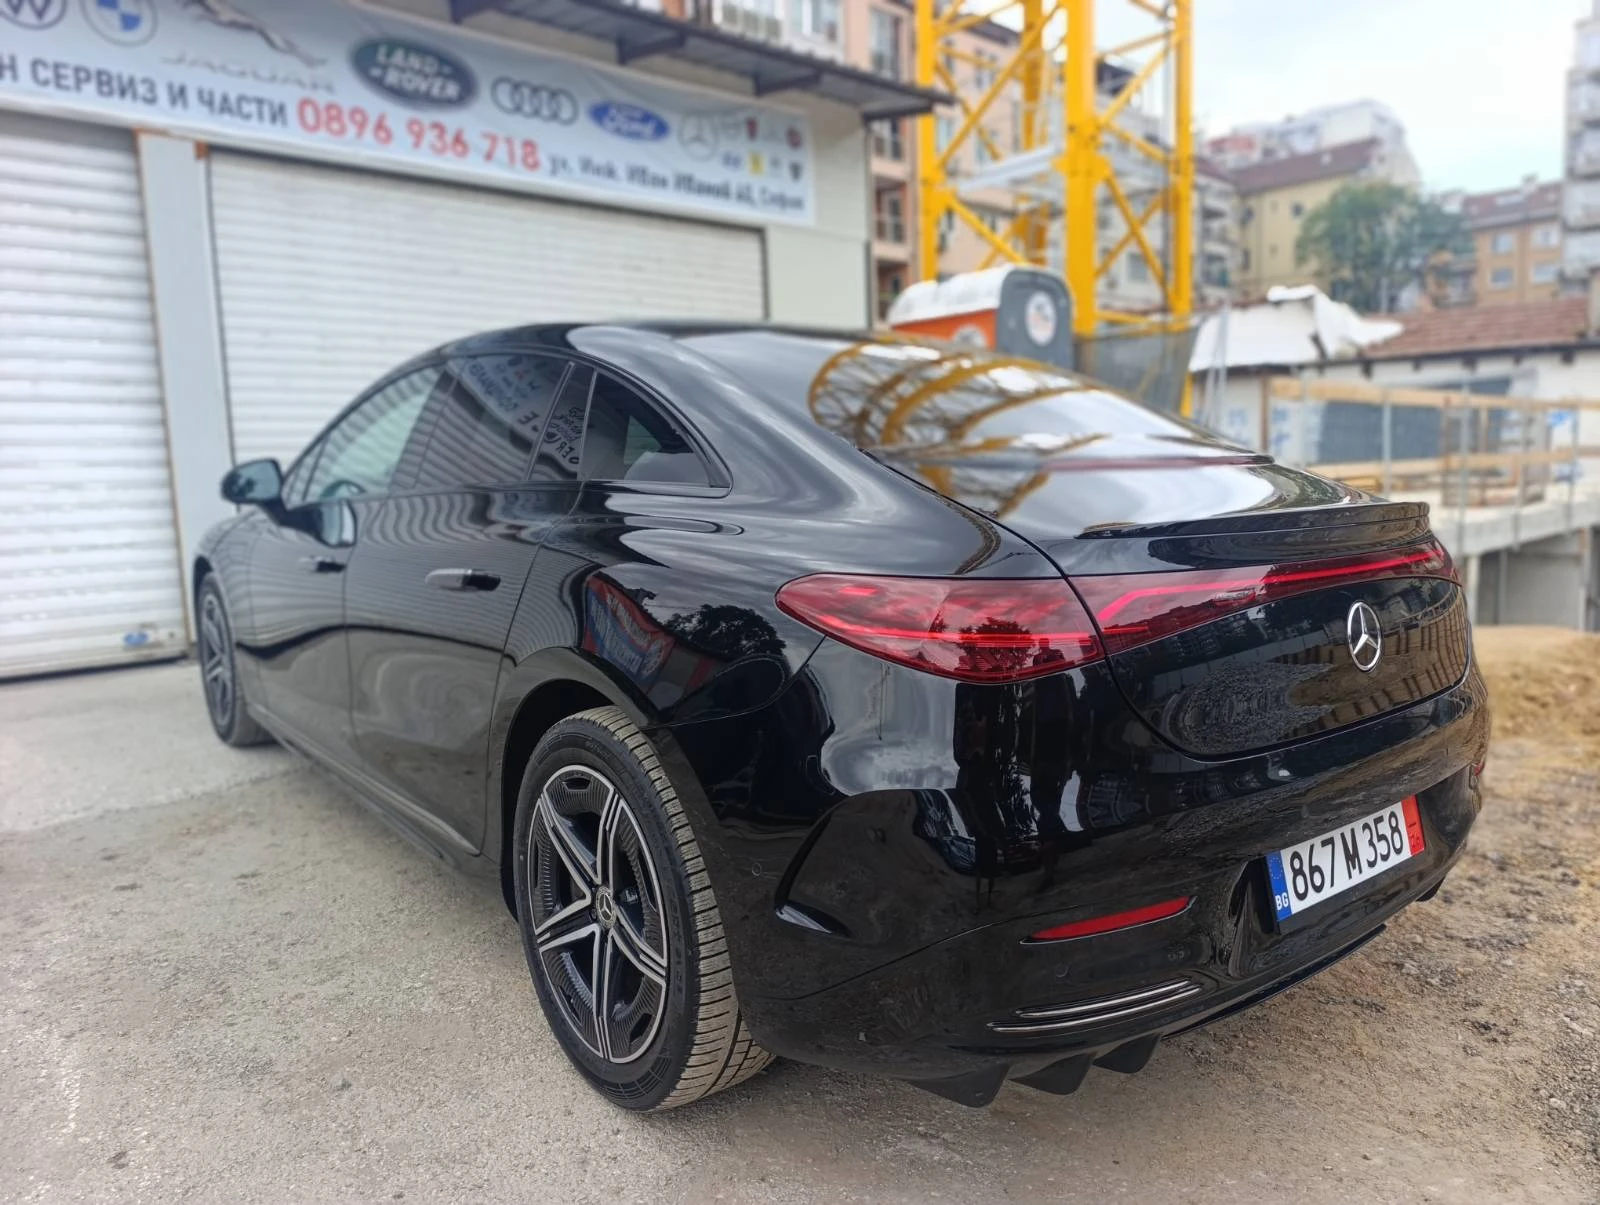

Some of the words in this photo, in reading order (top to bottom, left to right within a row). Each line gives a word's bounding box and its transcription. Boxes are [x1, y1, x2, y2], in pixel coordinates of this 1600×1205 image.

[375, 44, 440, 75] LAND
[384, 67, 460, 100] ROVER
[30, 57, 158, 106] СЕРВИЗ
[167, 80, 188, 110] И
[197, 86, 288, 128] ЧАСТИ
[297, 96, 393, 145] 0896
[406, 117, 469, 159] 936
[481, 130, 541, 171] 718
[1275, 891, 1290, 910] BG
